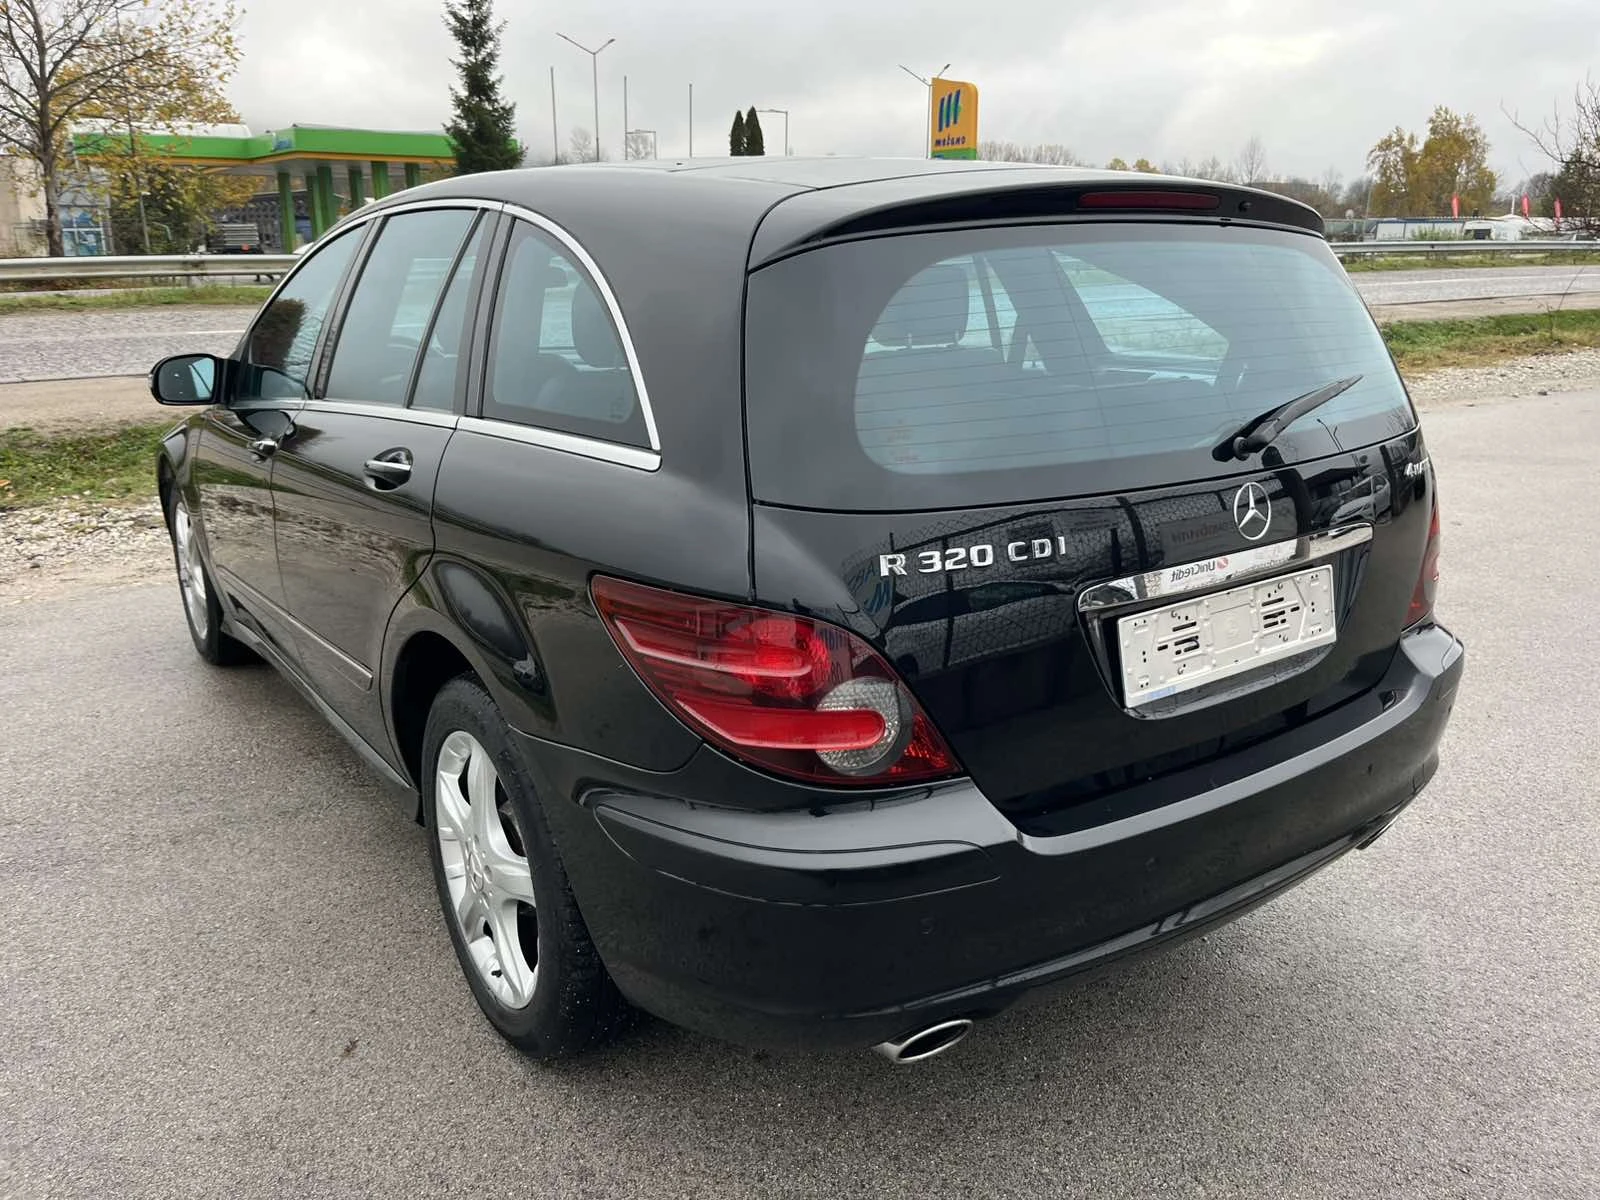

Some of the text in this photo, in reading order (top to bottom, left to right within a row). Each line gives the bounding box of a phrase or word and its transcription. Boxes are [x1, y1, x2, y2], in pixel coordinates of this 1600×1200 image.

[879, 536, 1066, 577] R 320 CDI
